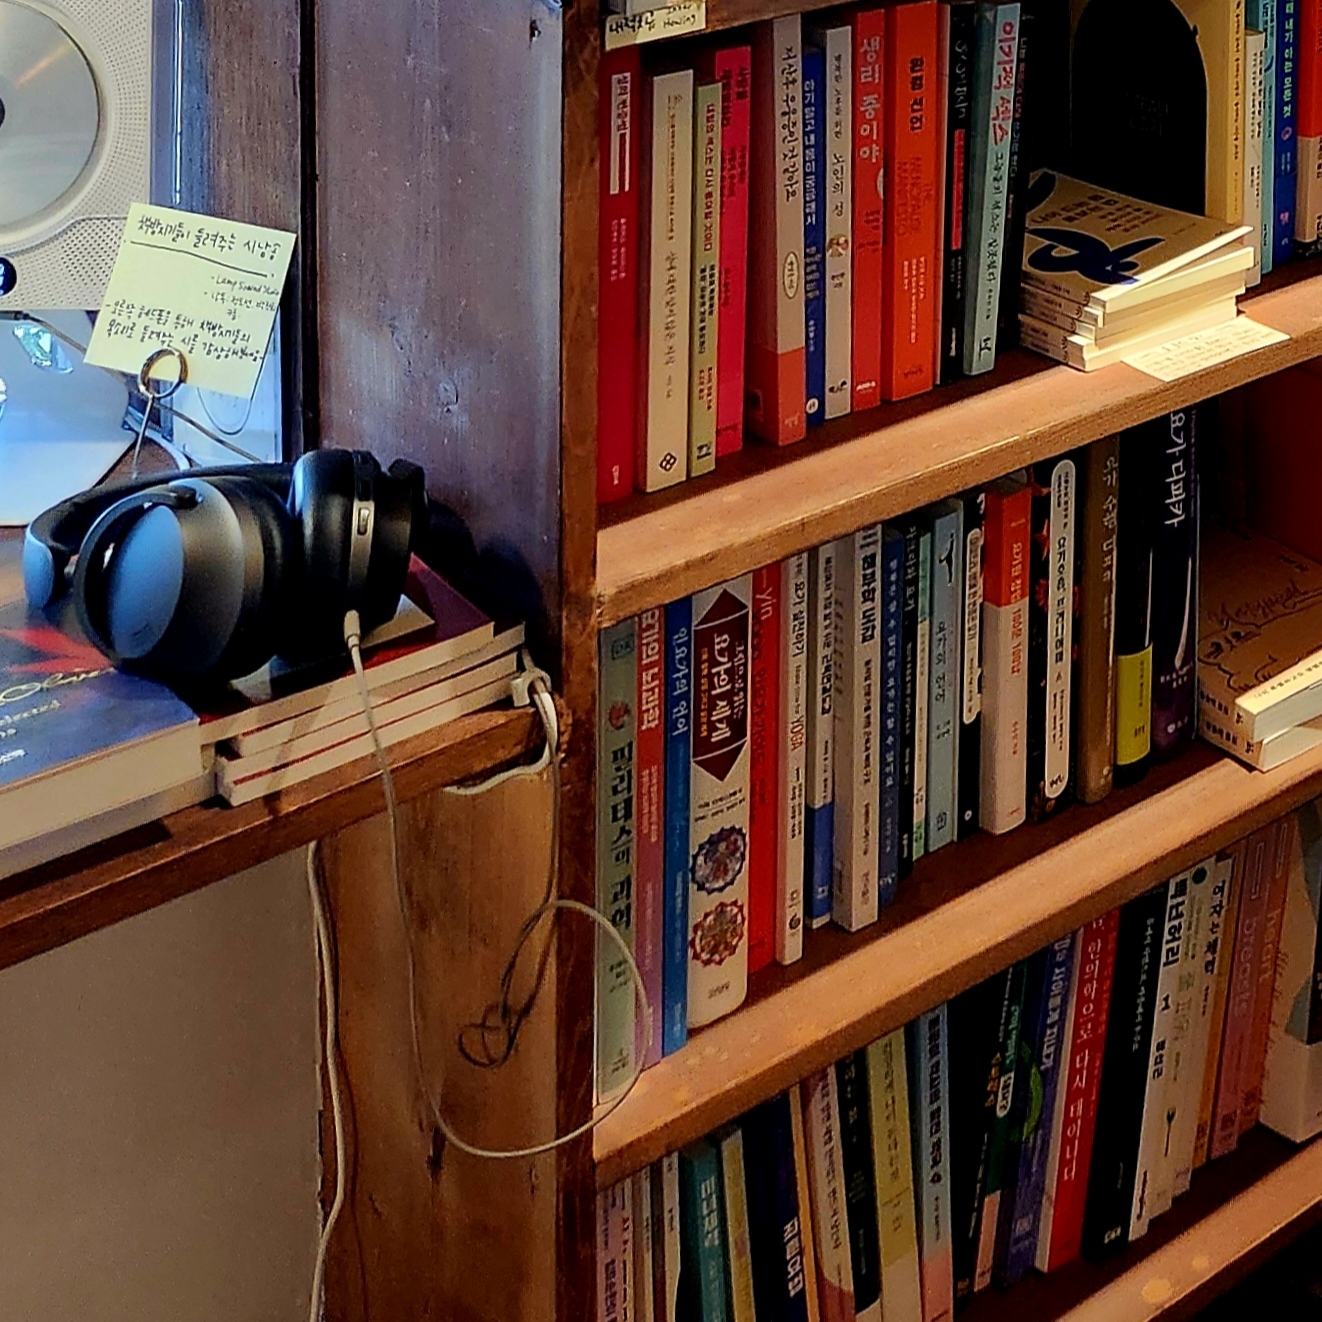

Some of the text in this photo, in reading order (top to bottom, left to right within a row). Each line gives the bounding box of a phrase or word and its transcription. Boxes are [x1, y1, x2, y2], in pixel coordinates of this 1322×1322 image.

[783, 46, 795, 60] 저
[1285, 18, 1294, 43] 내가
[782, 63, 797, 90] 산후
[994, 21, 1017, 90] 이기적
[781, 94, 797, 144] 우울증인
[859, 36, 880, 163] 생리 중이야
[992, 96, 1010, 146] 섹스
[705, 137, 715, 164] 섹스는
[705, 168, 714, 188] 다시
[784, 162, 799, 202] 같아요
[243, 239, 282, 261] 시낭송
[704, 224, 714, 252] 것이다
[1164, 413, 1187, 527] 요가 디피카
[755, 588, 776, 621] yin
[671, 628, 689, 736] 인요가의 언어
[711, 633, 732, 743] 요가의 세계
[789, 582, 806, 752] 요가 실천하기 YOGA
[641, 669, 658, 731] 뇌과학
[1162, 878, 1189, 969] 백년허리
[1072, 1049, 1089, 1089] 다시
